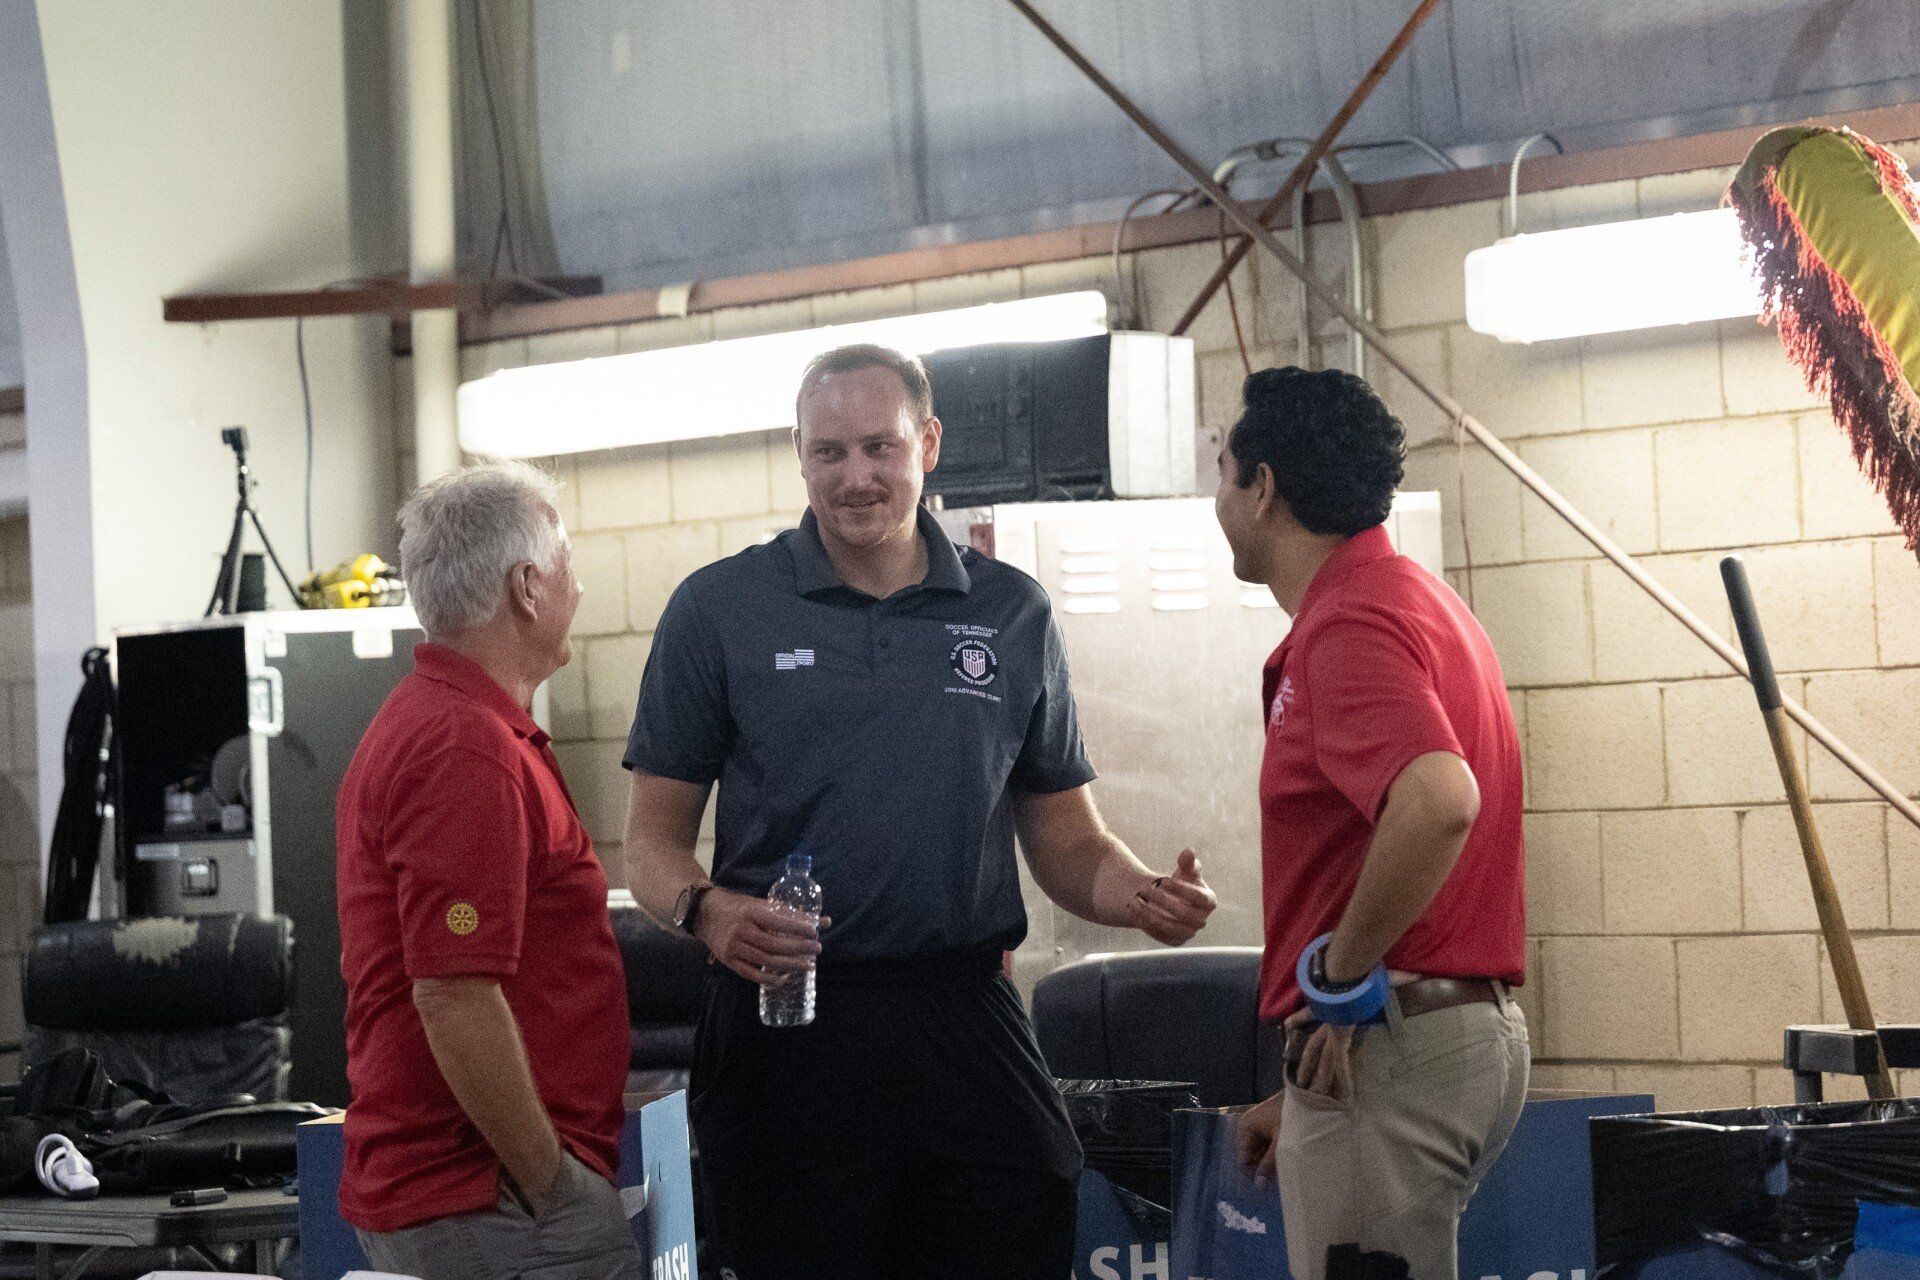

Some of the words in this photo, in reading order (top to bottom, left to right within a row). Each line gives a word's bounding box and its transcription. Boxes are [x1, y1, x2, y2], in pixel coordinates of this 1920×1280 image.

[970, 625, 998, 634] OFFICIALS
[953, 640, 973, 652] SOCCER
[973, 640, 997, 665] FEDERATION
[964, 650, 984, 662] USA
[957, 688, 986, 698] ADVANCED
